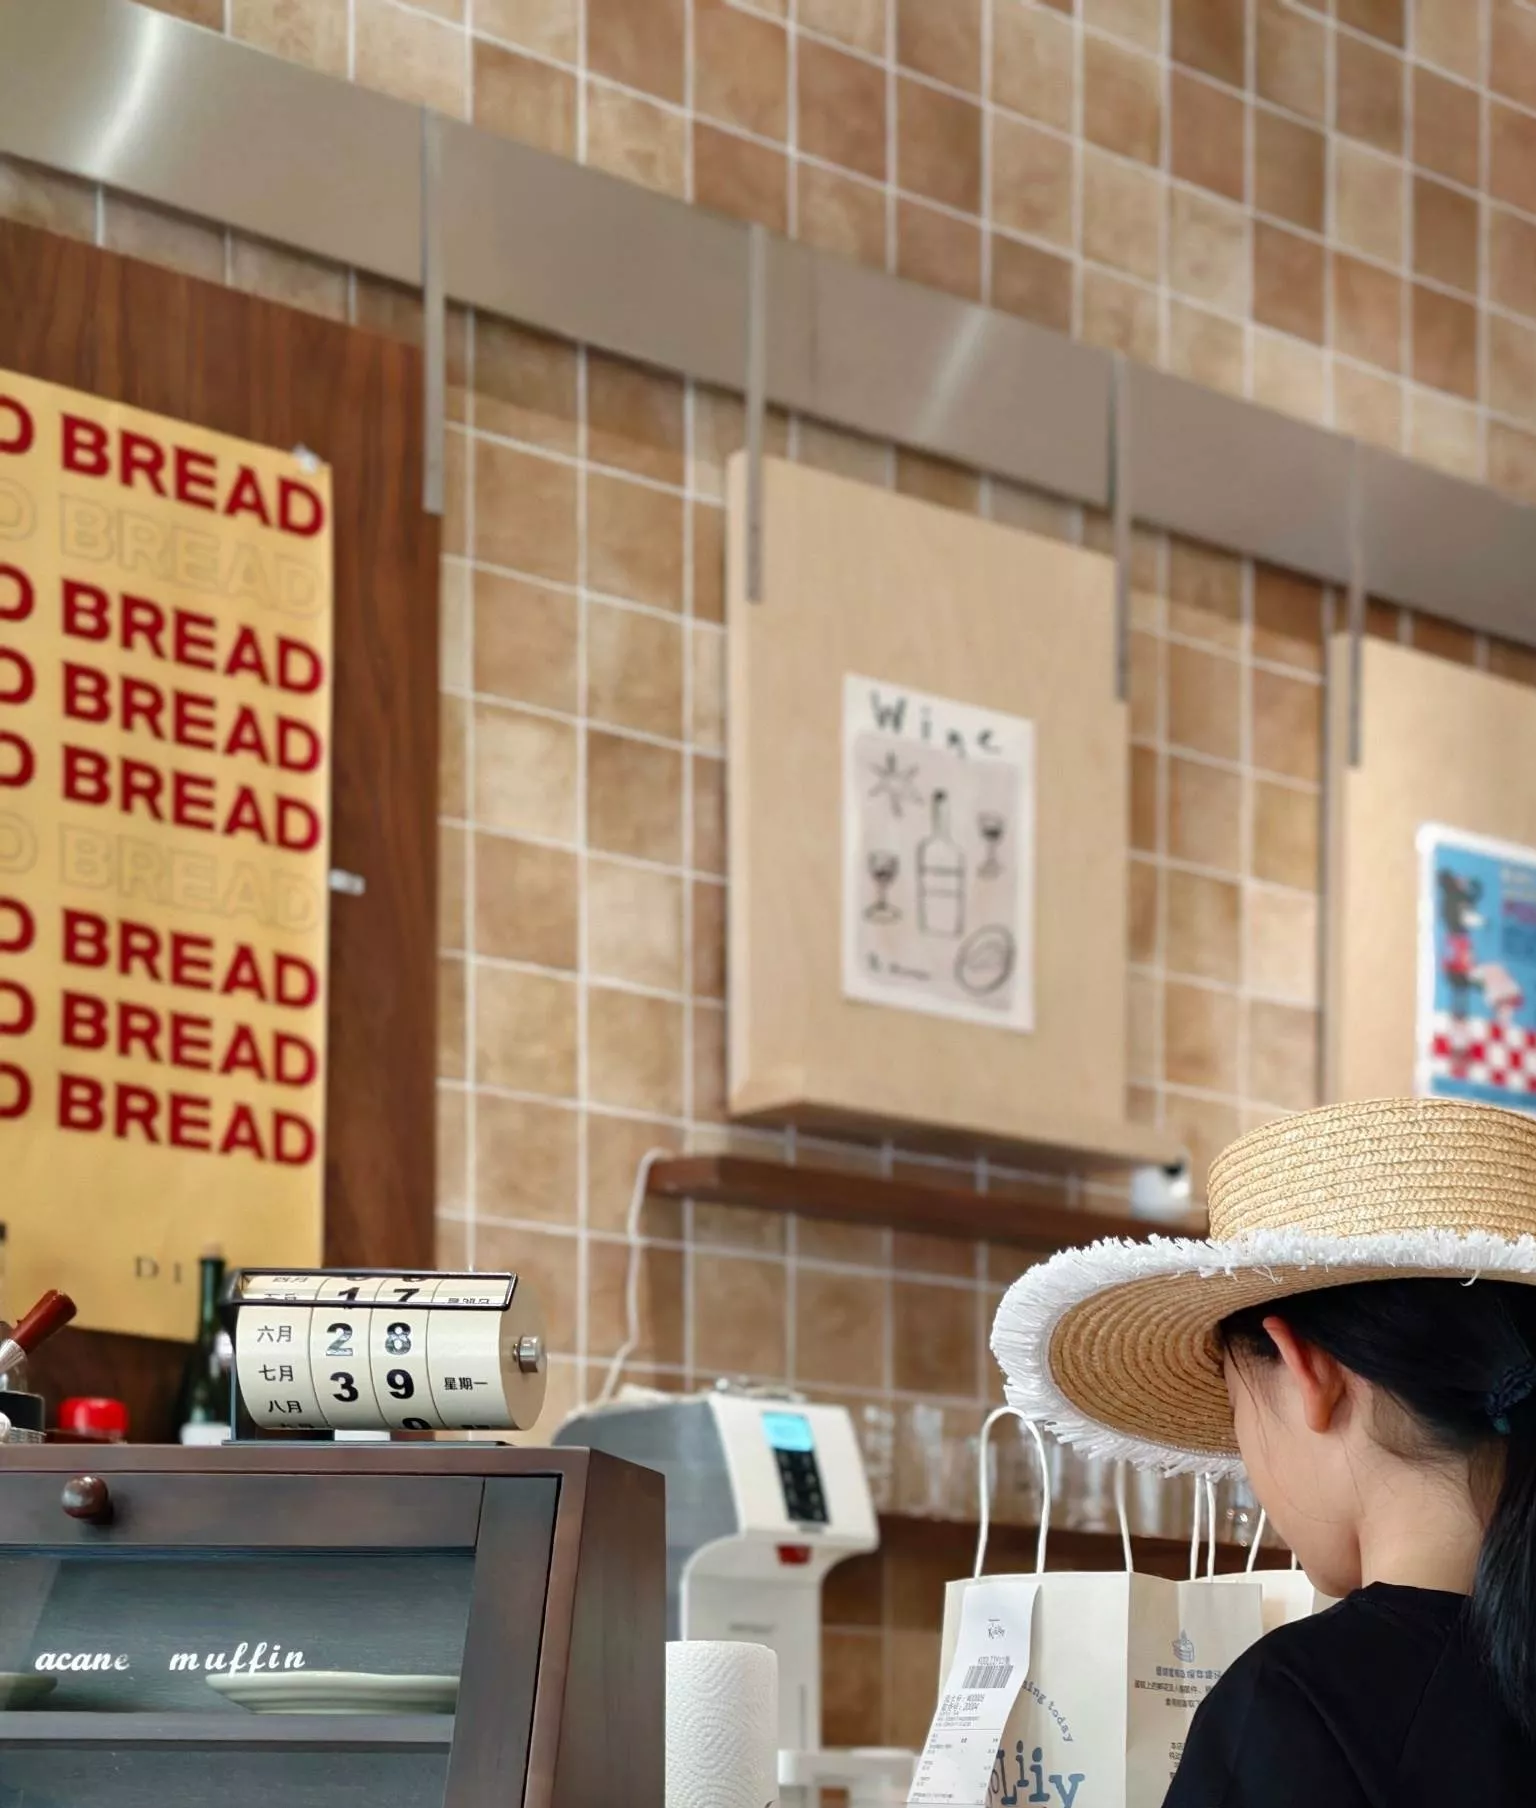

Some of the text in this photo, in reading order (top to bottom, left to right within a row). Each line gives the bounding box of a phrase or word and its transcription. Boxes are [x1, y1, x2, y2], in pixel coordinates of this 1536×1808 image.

[61, 412, 324, 539] BREAD
[59, 492, 328, 622] BREAD
[61, 578, 324, 697] BREAD
[61, 660, 324, 775] BREAD
[868, 688, 1004, 763] Wine
[61, 744, 322, 854] BREAD
[58, 825, 324, 935] BREAD
[61, 908, 320, 1010] BREAD
[61, 990, 318, 1090] BREAD
[56, 1072, 317, 1169] BREAD
[257, 1325, 294, 1344] 六月
[258, 1363, 295, 1384] 七月
[325, 1321, 413, 1357] 2 8
[267, 1400, 303, 1415] 八月
[329, 1368, 415, 1403] 3 9
[443, 1376, 489, 1392] 星期一
[168, 1641, 306, 1677] muffin
[1047, 1700, 1074, 1743] today
